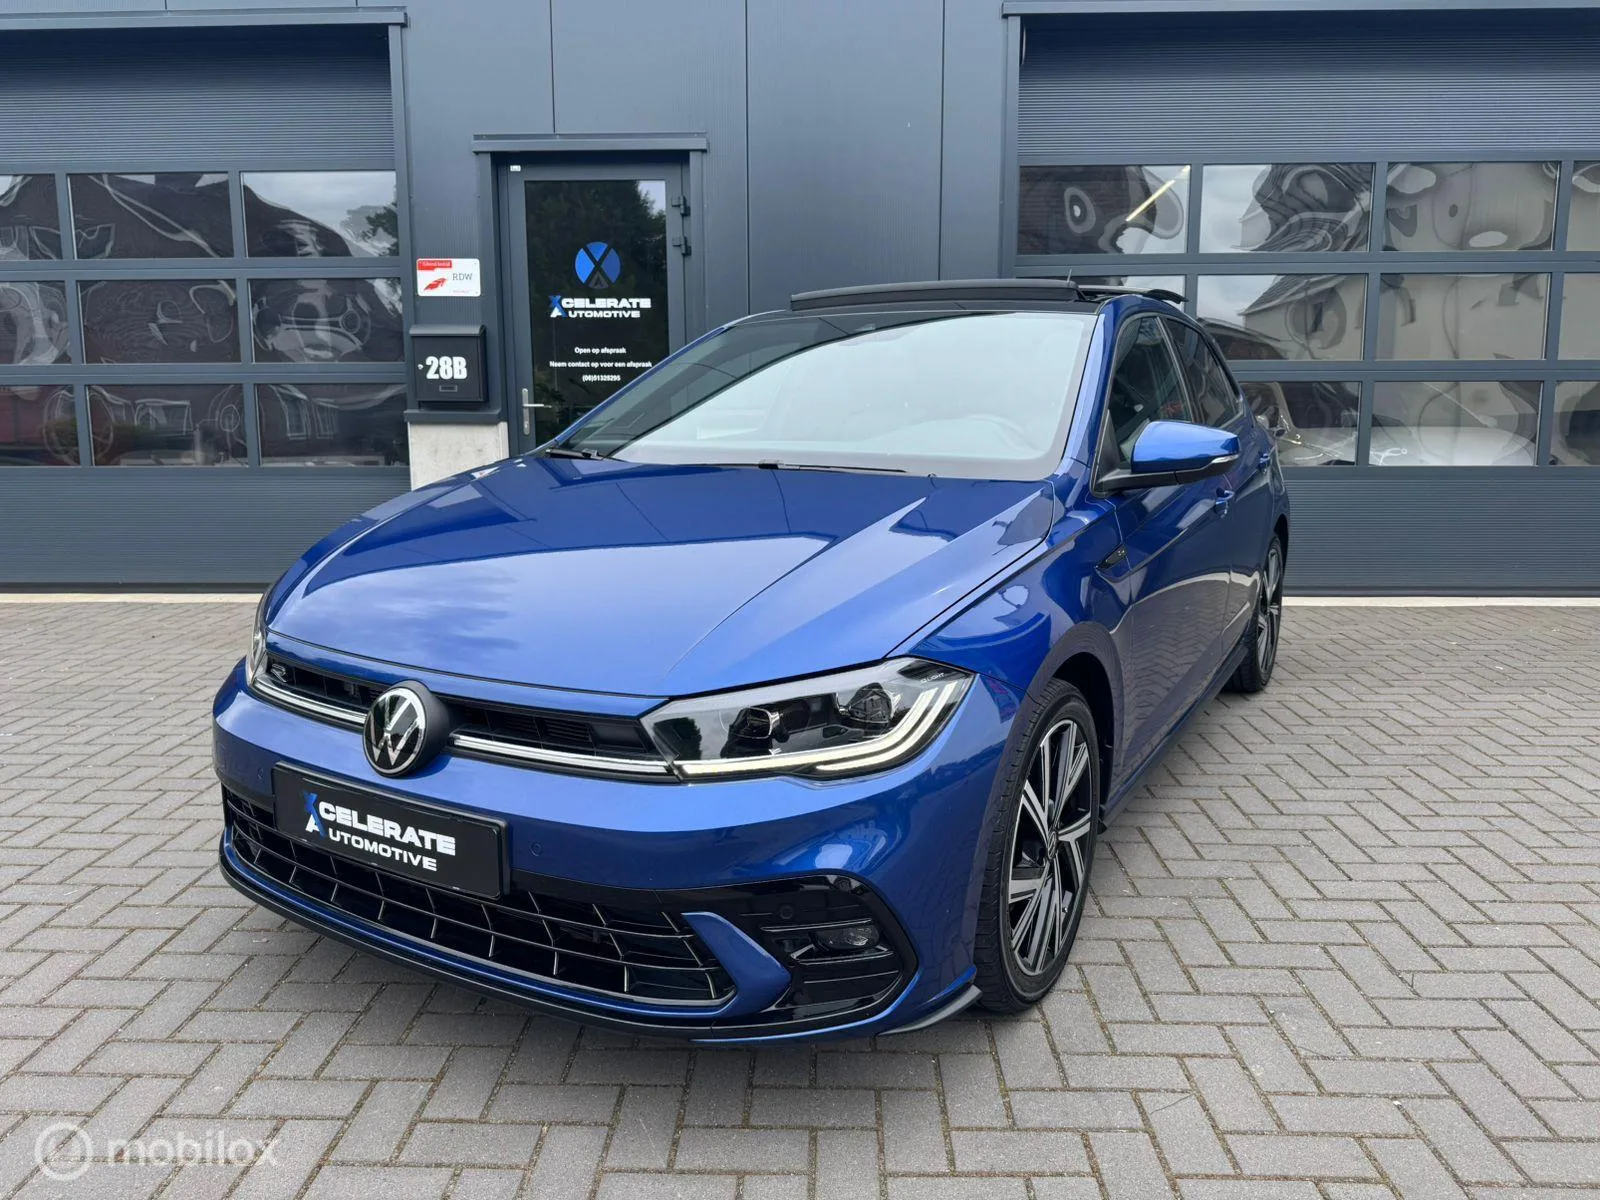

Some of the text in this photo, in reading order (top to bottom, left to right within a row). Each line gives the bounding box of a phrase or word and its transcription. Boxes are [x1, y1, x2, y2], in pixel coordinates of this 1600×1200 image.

[452, 273, 473, 281] RDW
[548, 295, 652, 309] XCELERATE
[550, 307, 641, 318] AUTOMOTIVE
[574, 347, 591, 355] Open
[601, 347, 627, 355] afspraak
[425, 355, 467, 380] 28B
[626, 361, 653, 369] afspraak
[303, 789, 456, 856] XCELERATE
[305, 814, 437, 872] AUTOMOTIVE
